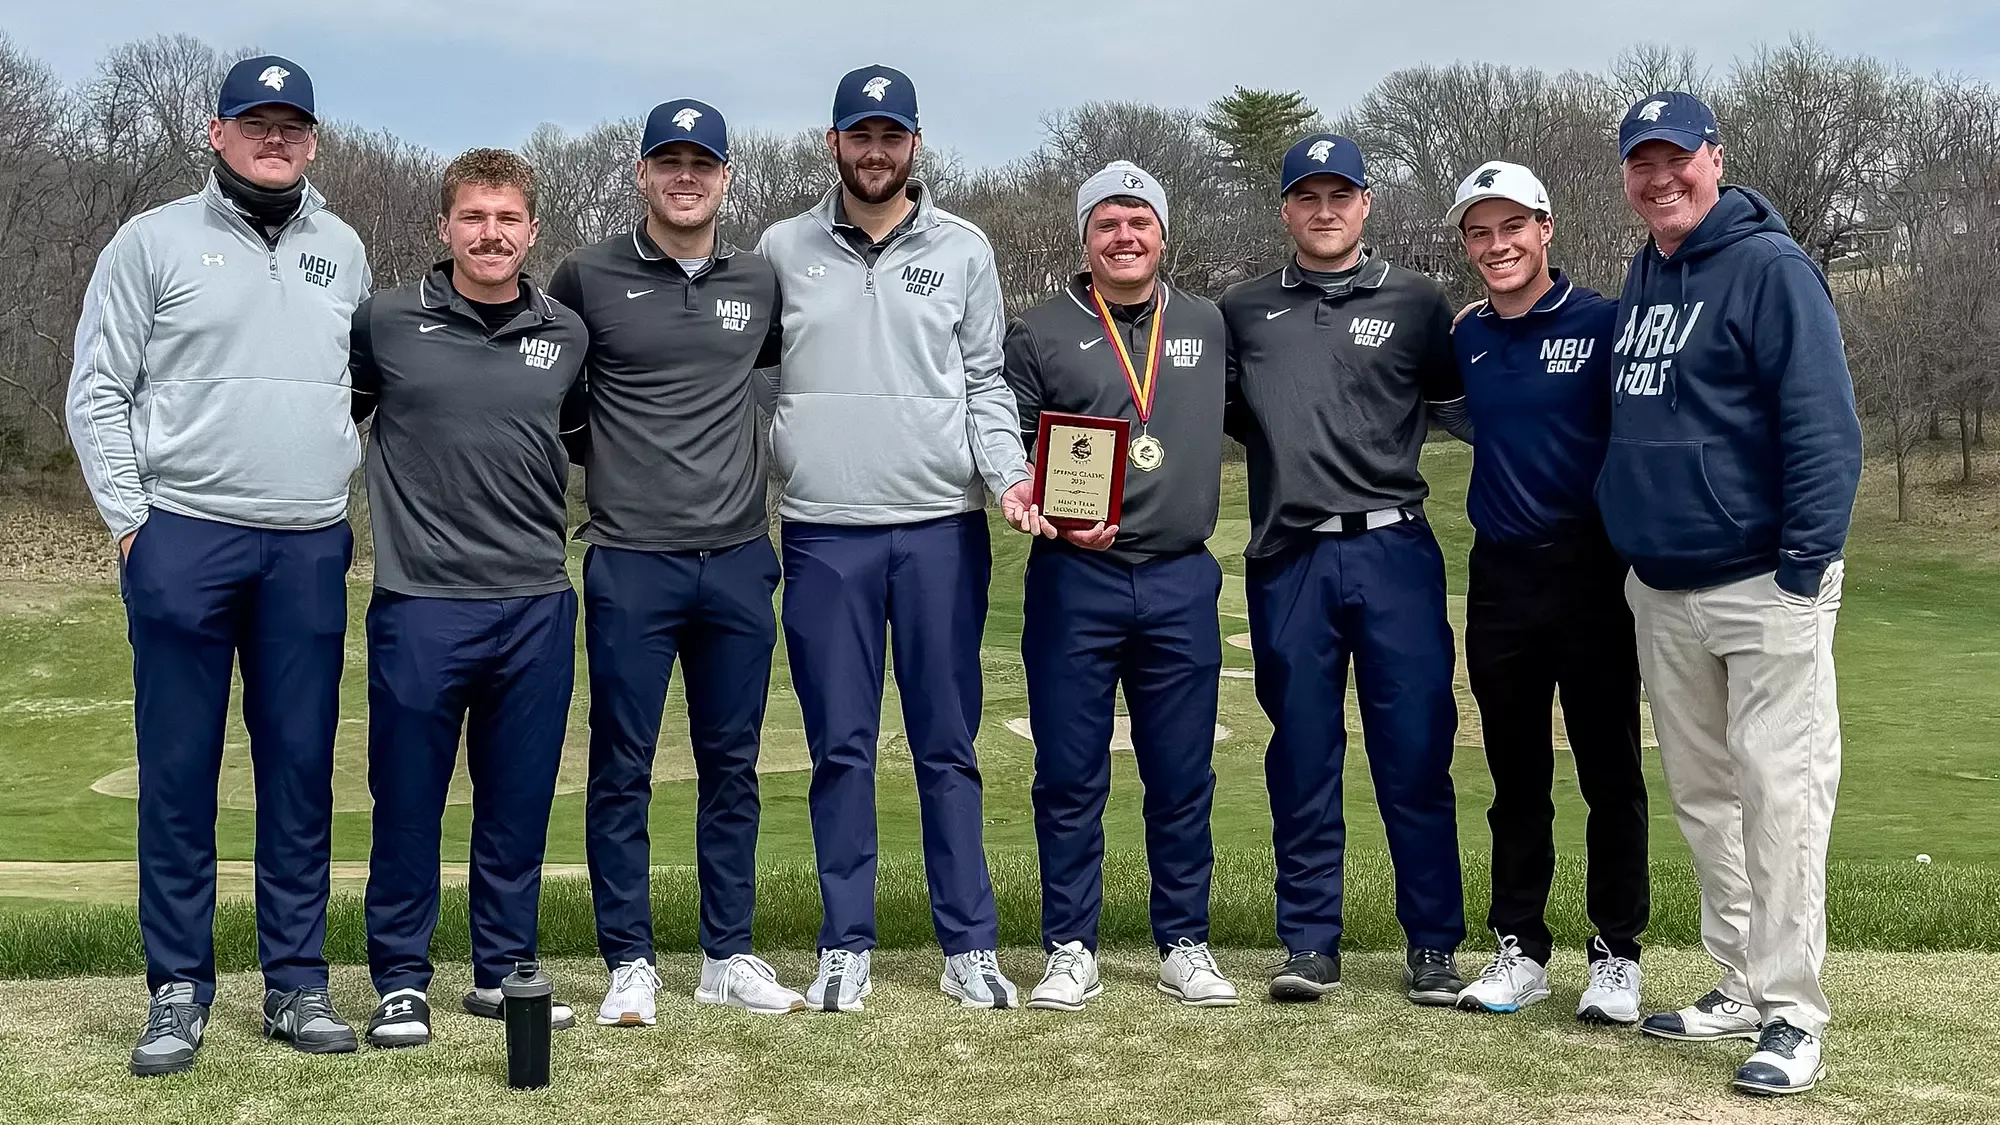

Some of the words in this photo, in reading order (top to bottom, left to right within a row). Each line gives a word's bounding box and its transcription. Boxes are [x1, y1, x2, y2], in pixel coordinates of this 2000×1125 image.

[299, 252, 338, 279] MBU
[305, 272, 332, 288] GOLF
[901, 265, 945, 288] MBU
[905, 282, 936, 297] GOLF
[716, 299, 751, 321] MBU
[722, 317, 748, 332] GOLF
[1349, 317, 1395, 338] MBU
[1614, 301, 1705, 358] MBU
[519, 337, 562, 362] MBU
[1165, 338, 1203, 357] MBU
[1354, 334, 1385, 348] GOLF
[1540, 338, 1595, 360] MBU
[525, 354, 556, 370] GOLF
[1173, 355, 1200, 368] GOLF
[1546, 359, 1586, 373] GOLF
